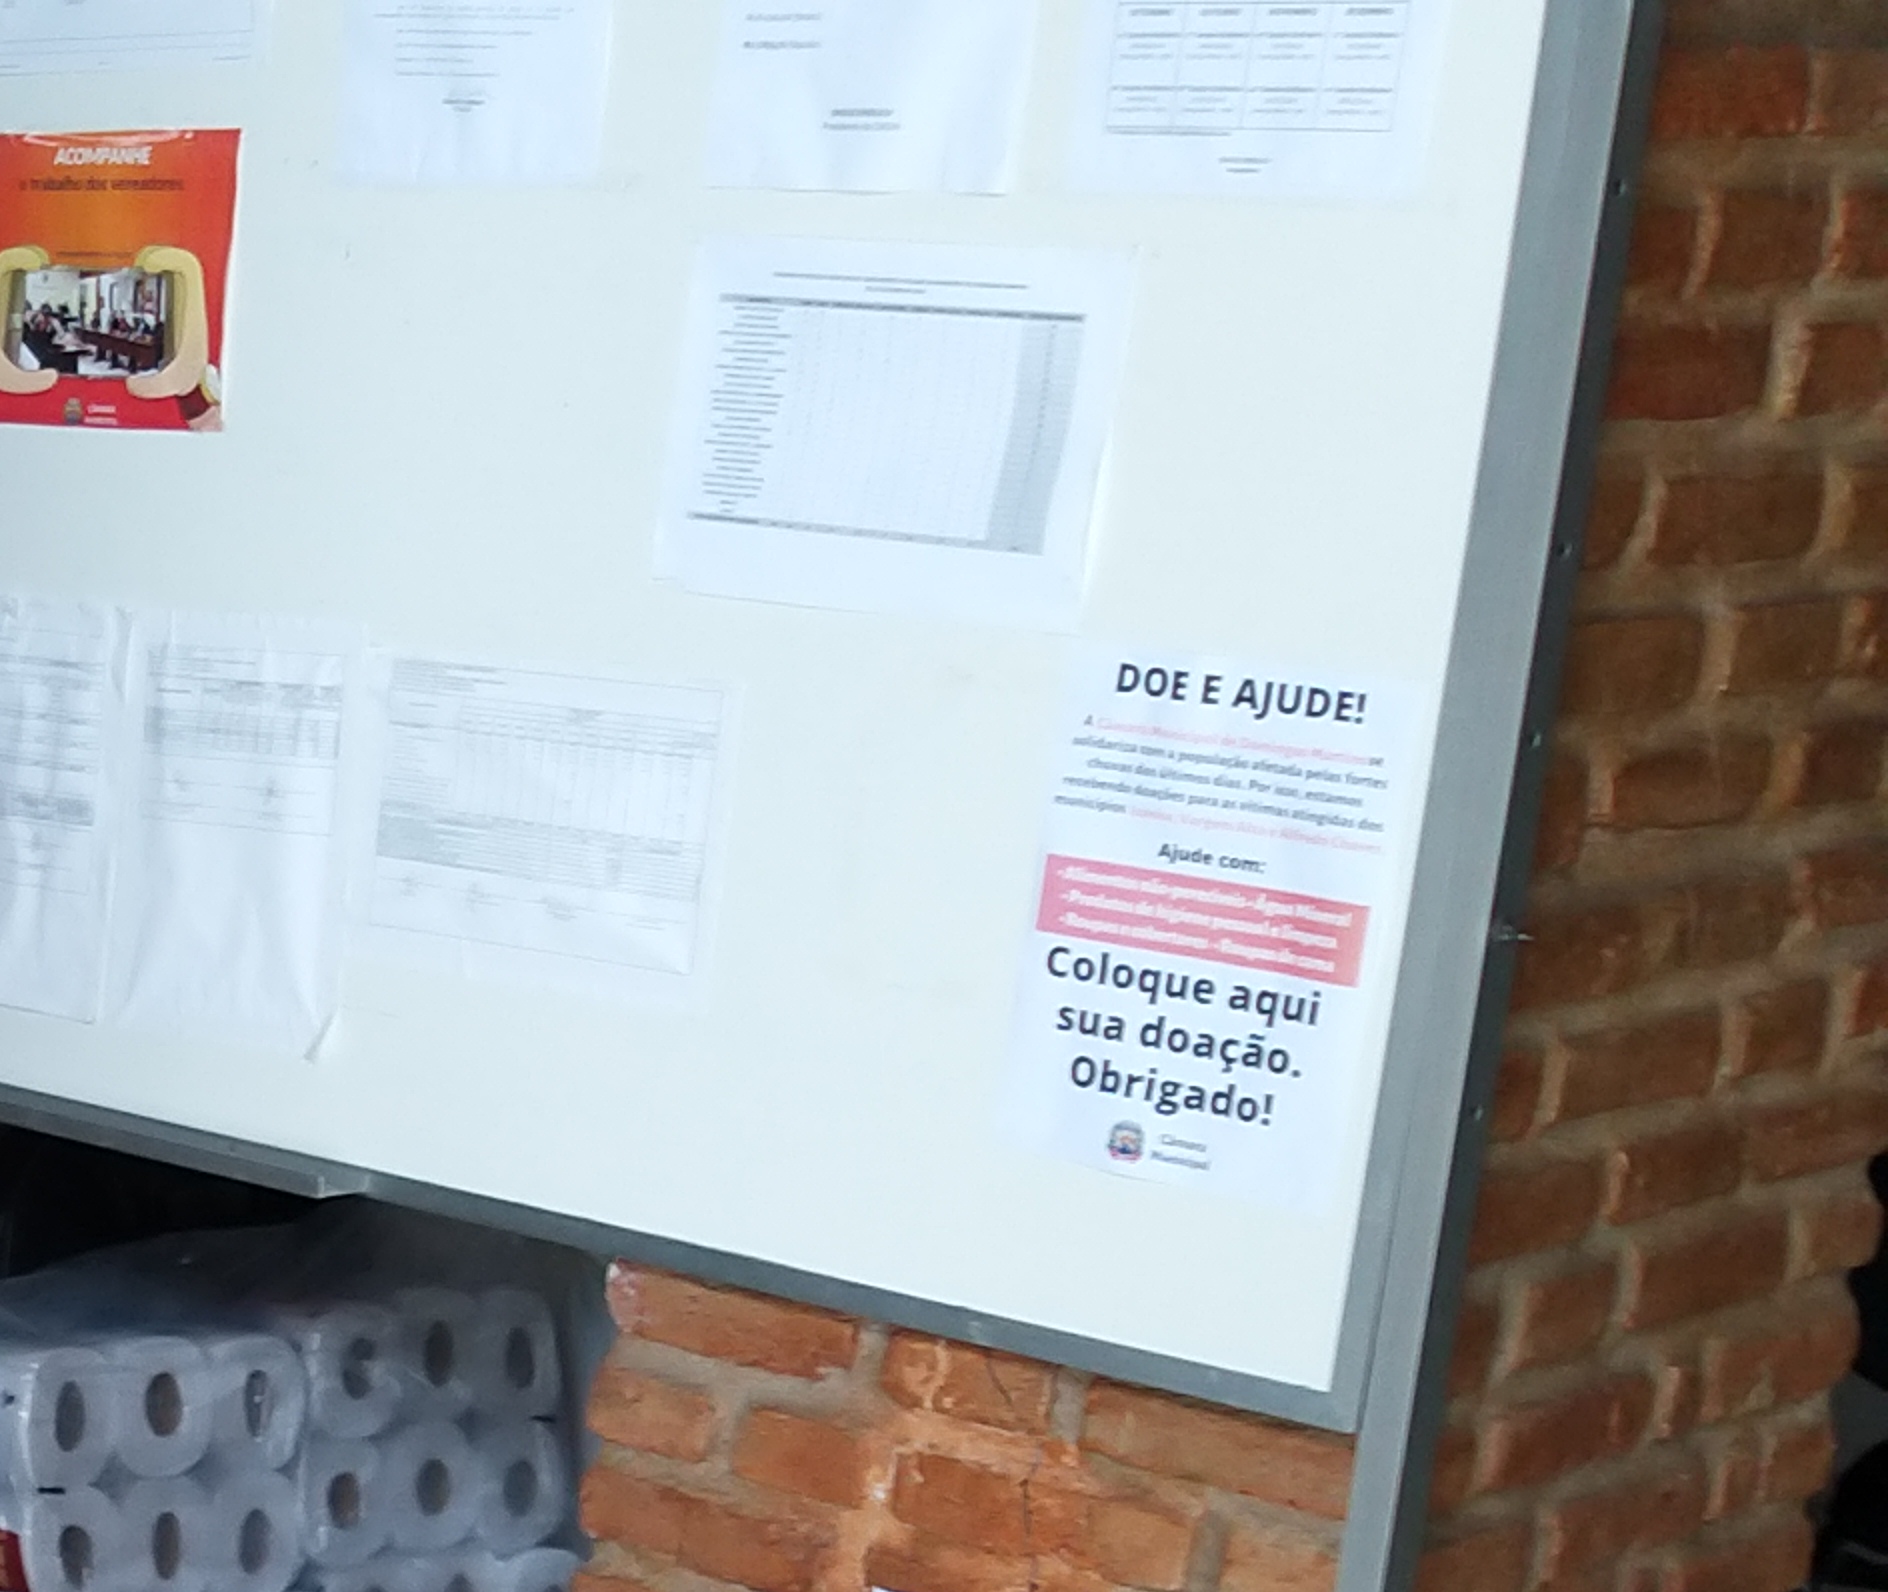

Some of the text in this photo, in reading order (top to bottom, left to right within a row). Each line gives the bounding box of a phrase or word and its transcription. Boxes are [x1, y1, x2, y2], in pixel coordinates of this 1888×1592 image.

[53, 145, 153, 165] ACOMPANHE
[1115, 661, 1368, 724] DOE E AJUDE!
[1157, 842, 1267, 875] Ajude com:
[1046, 946, 1322, 1028] Coloque aqui
[1056, 1004, 1303, 1079] sua doação.
[1070, 1054, 1275, 1127] Obrigado!
